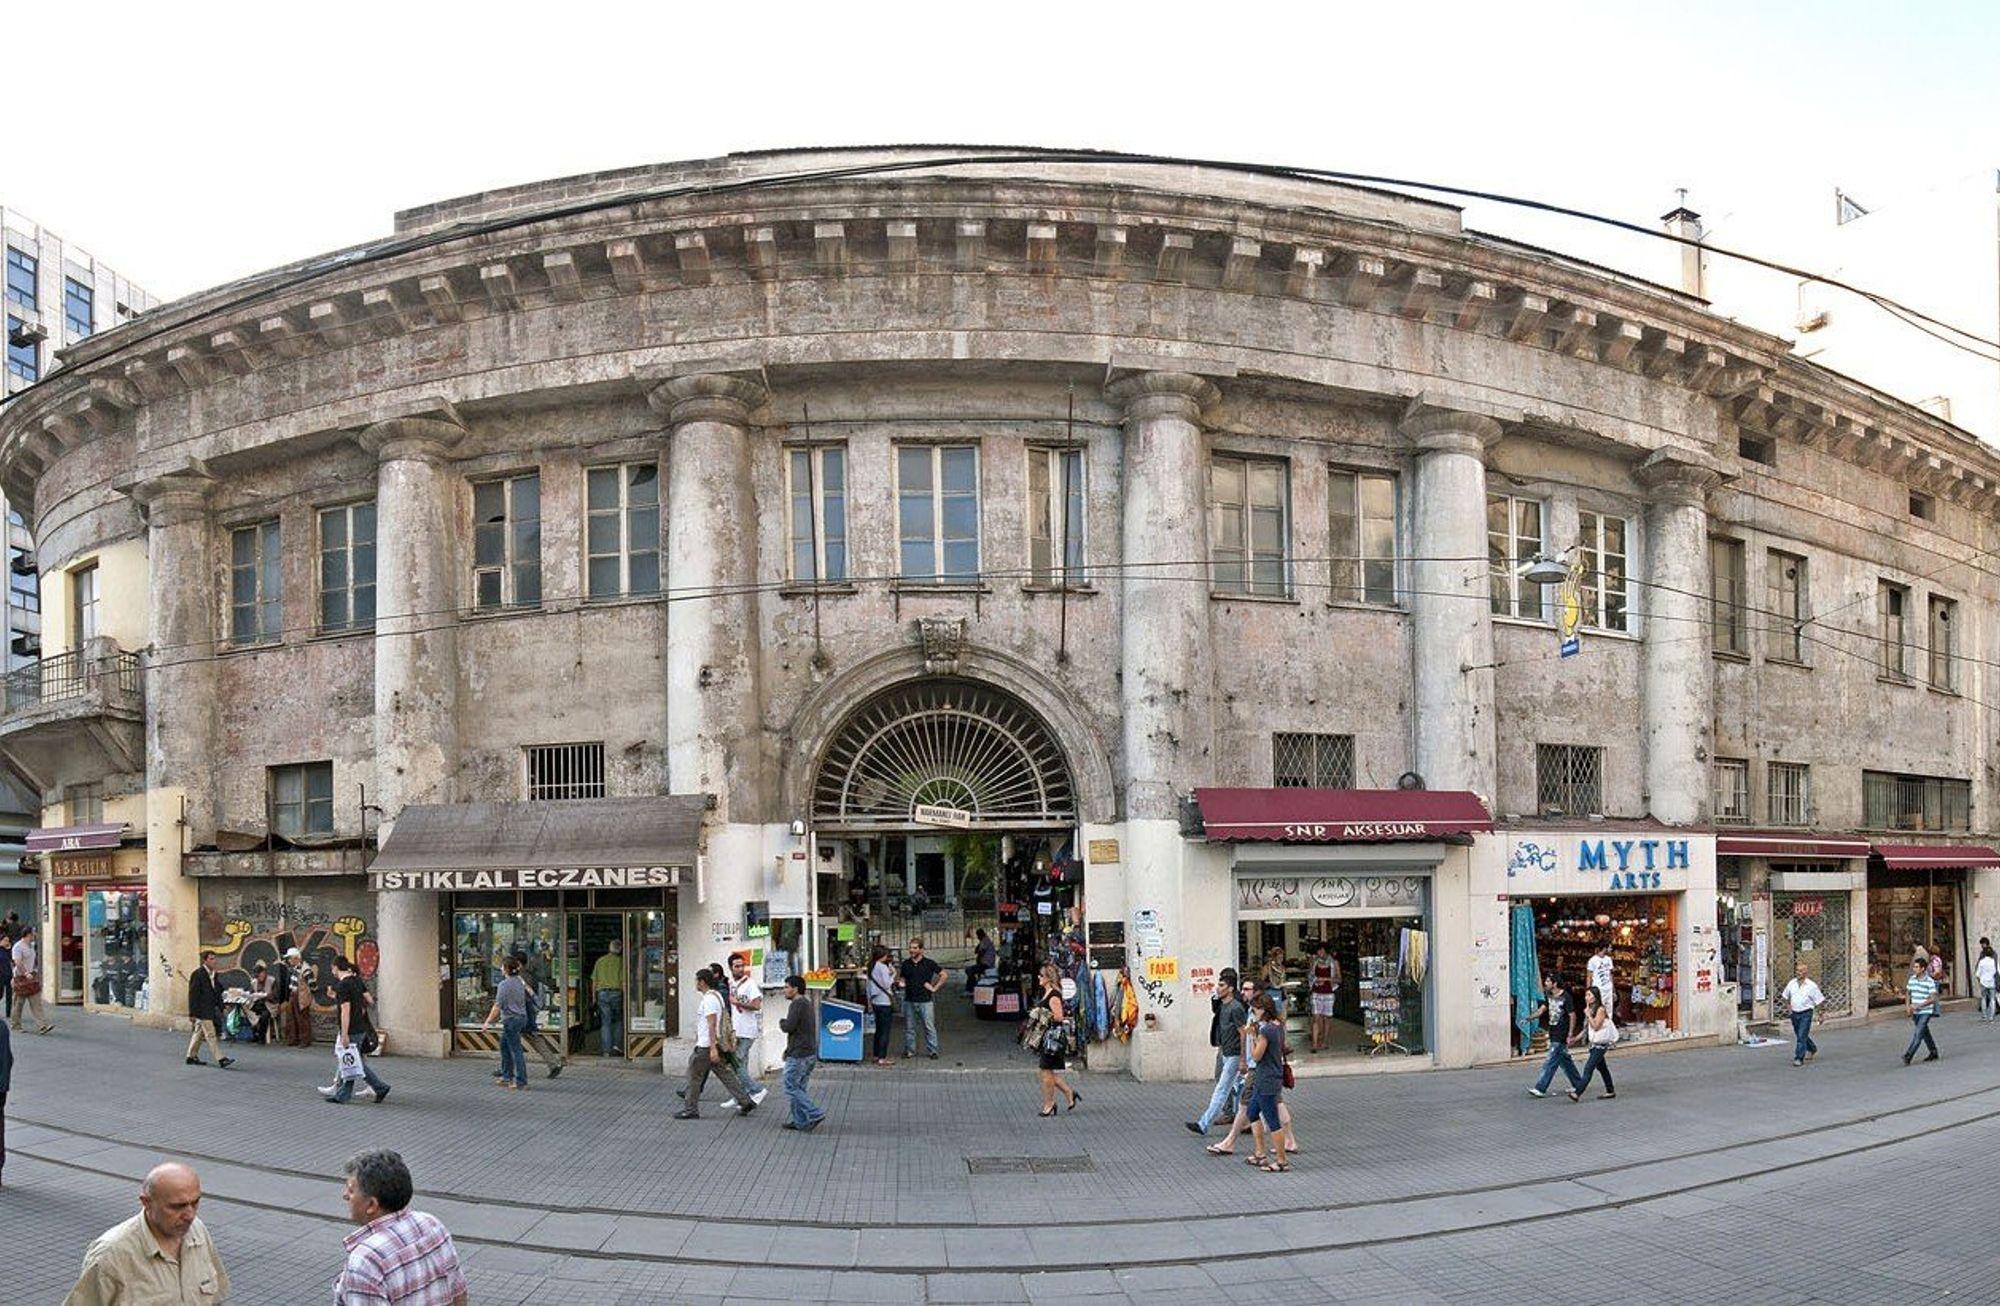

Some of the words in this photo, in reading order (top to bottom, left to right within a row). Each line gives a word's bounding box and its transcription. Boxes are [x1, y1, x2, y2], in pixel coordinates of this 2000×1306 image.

[1284, 825, 1326, 837] SNR
[1343, 823, 1426, 837] AKSESUAR
[1578, 839, 1690, 871] MYTH
[1610, 872, 1661, 890] ARTS
